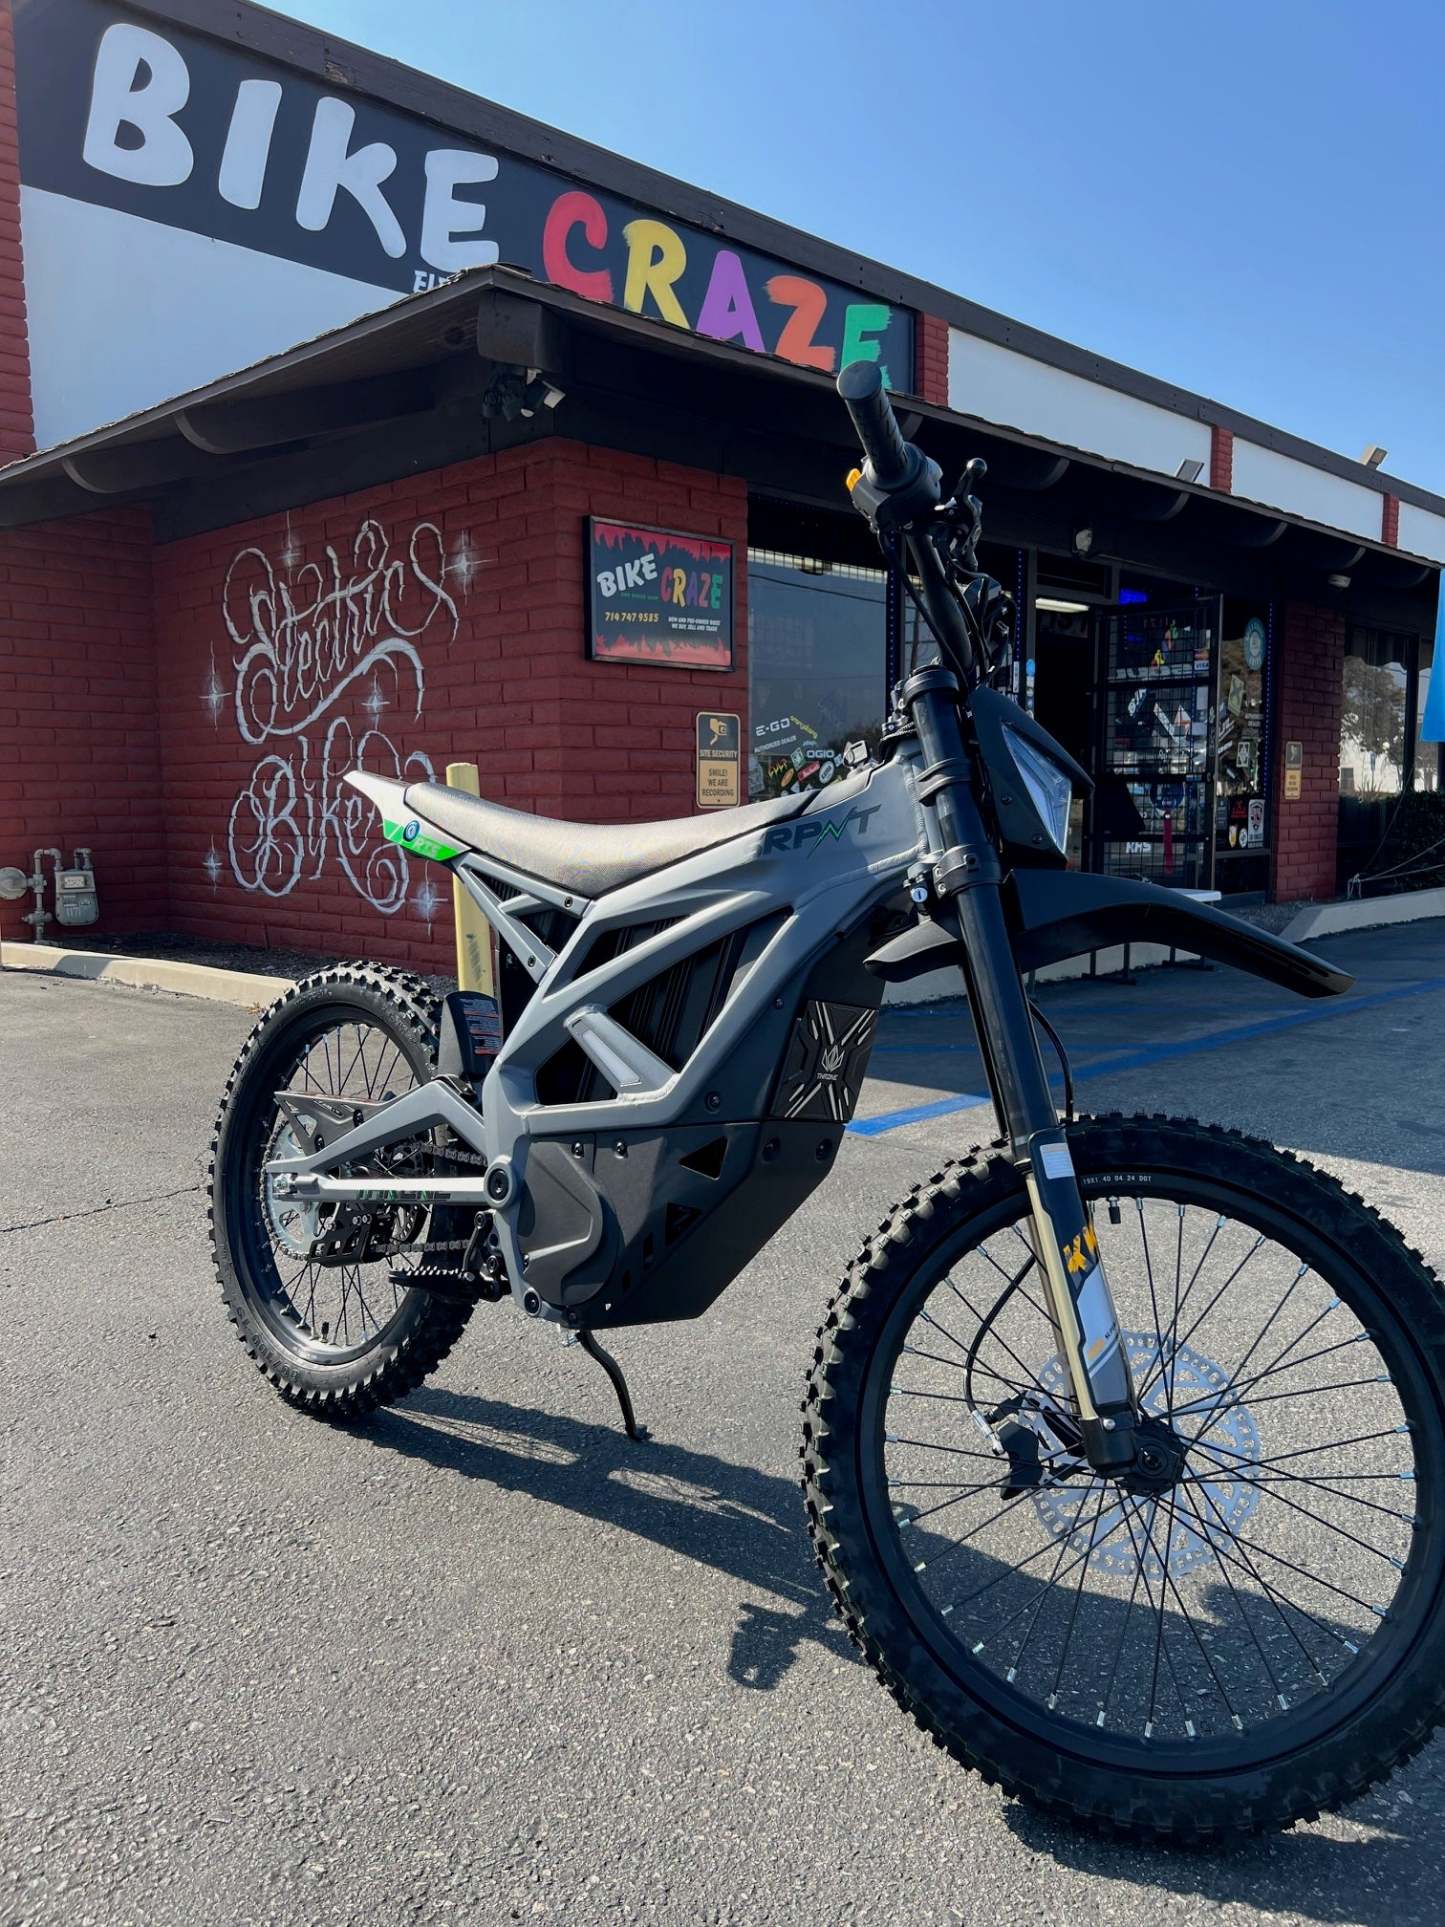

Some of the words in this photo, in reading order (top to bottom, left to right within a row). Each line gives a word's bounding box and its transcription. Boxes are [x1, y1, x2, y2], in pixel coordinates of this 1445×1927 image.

[83, 23, 500, 272] BIKE
[542, 191, 893, 390] CRAZE
[597, 553, 658, 598] BIKE
[660, 566, 723, 609] CRAZE
[806, 749, 835, 759] OGIO
[708, 778, 717, 787] WE
[717, 779, 729, 787] ARE
[702, 788, 735, 798] RECORDING
